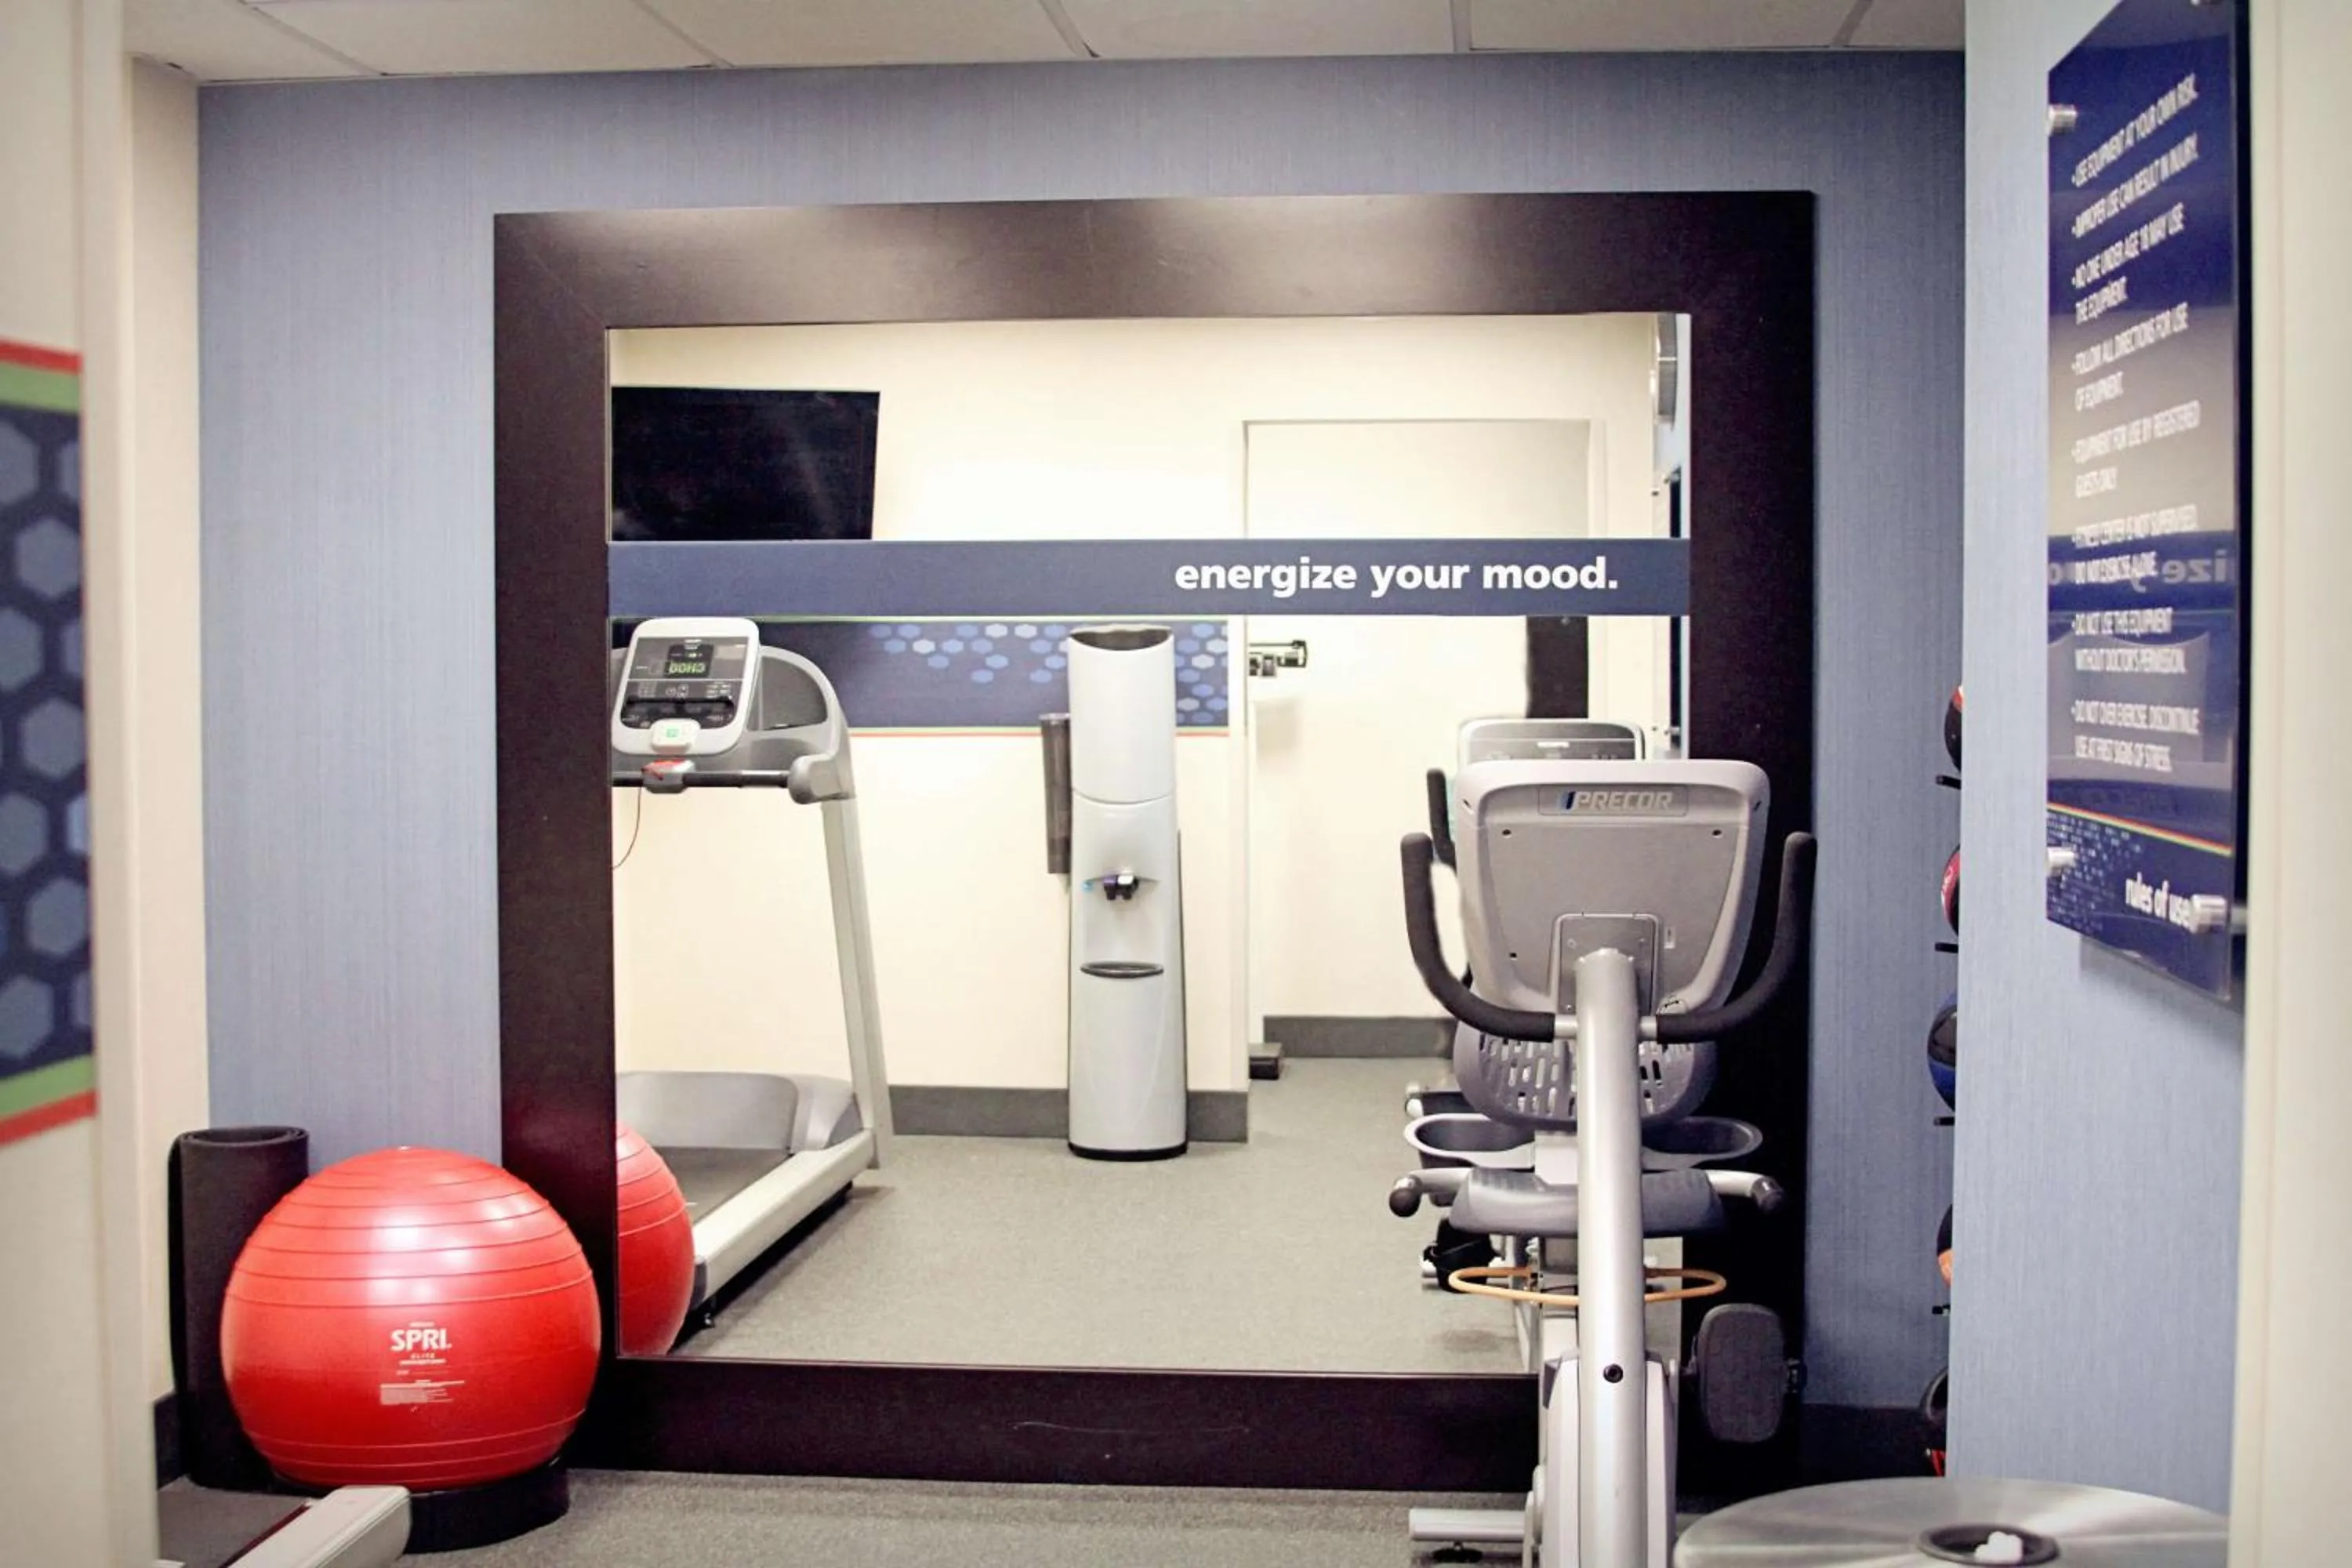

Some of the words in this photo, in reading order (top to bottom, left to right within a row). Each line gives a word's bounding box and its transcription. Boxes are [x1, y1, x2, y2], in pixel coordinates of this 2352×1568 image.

[1175, 557, 1357, 598] energize
[1370, 563, 1469, 598] your
[1483, 557, 1617, 590] mood.
[1572, 790, 1673, 810] PRECOR
[2125, 872, 2153, 914] rules
[2154, 880, 2169, 920] of
